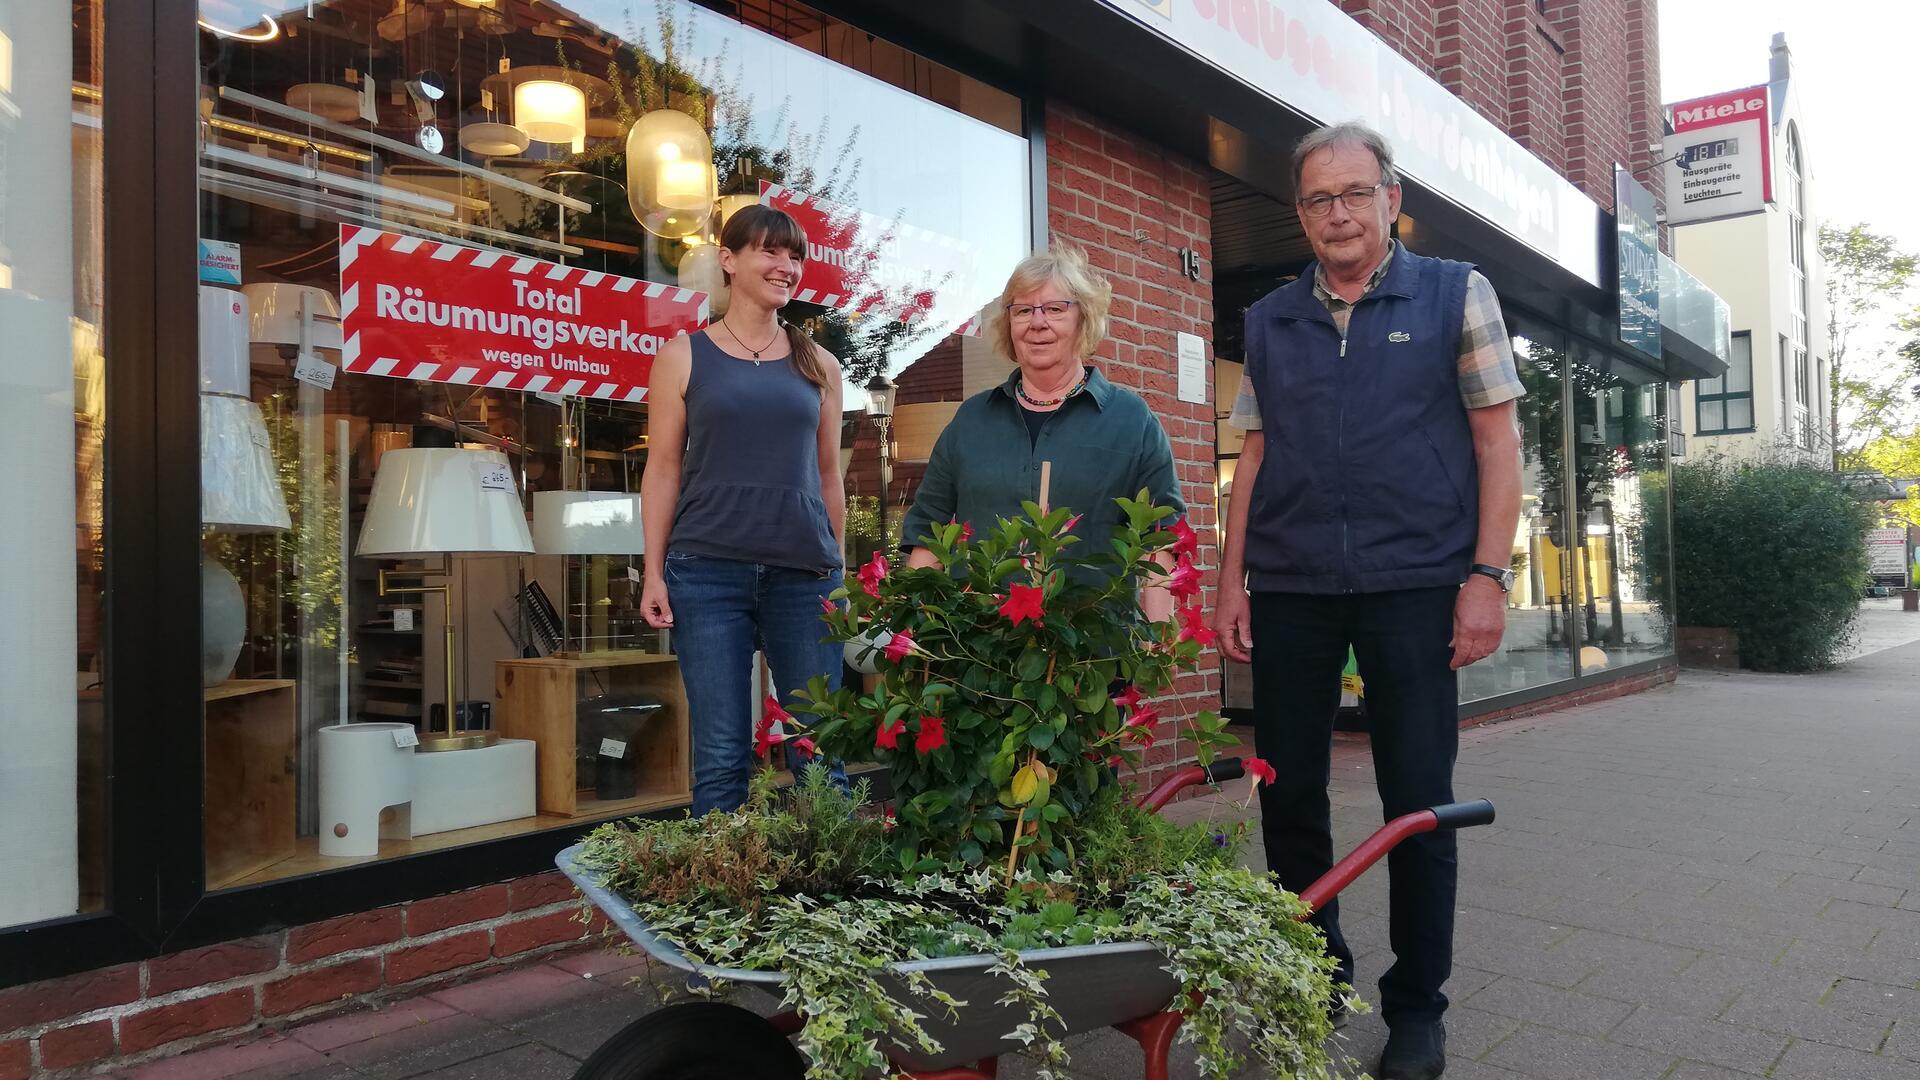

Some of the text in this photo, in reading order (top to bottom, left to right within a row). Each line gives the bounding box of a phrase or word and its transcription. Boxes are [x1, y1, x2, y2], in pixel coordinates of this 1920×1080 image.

[1676, 98, 1764, 126] Miele
[1682, 162, 1733, 178] Hausgeräte
[1683, 173, 1741, 189] Einbaugeräte
[1684, 188, 1722, 200] Leuchten
[1179, 247, 1201, 282] 15
[512, 279, 581, 315] Total
[481, 348, 610, 376] wegen Umbau
